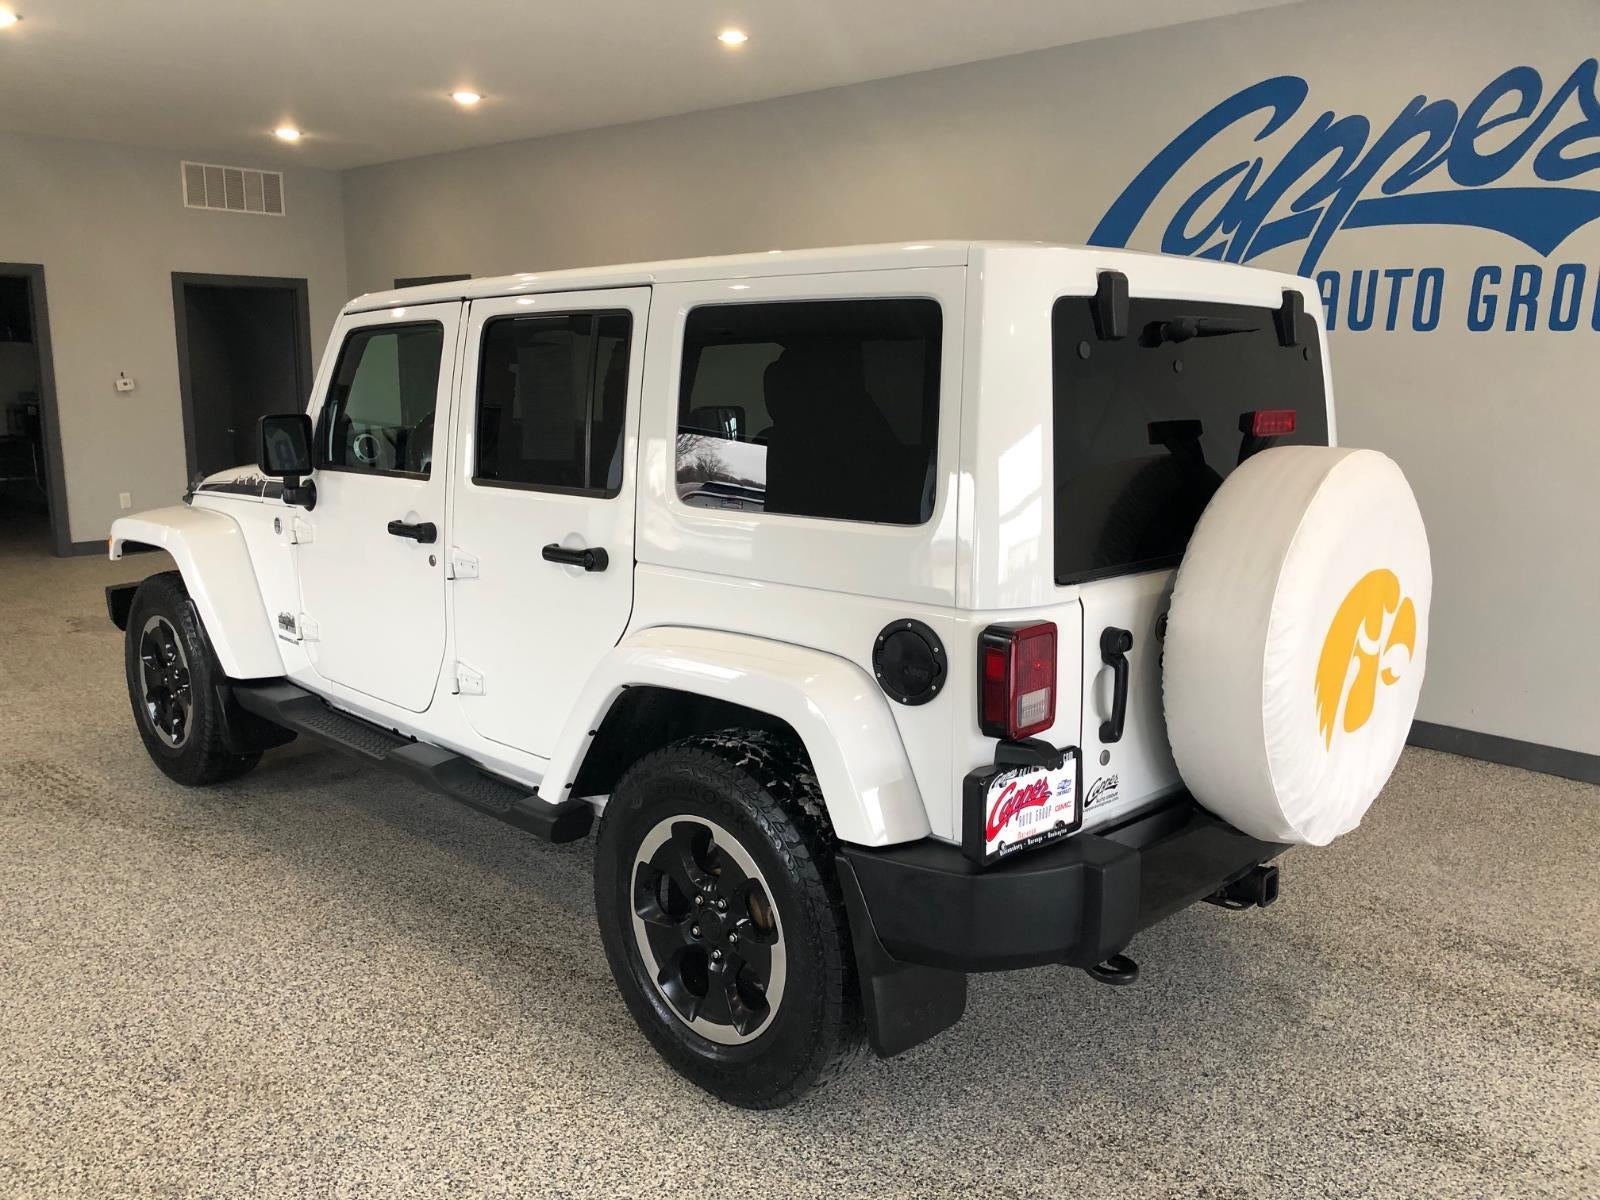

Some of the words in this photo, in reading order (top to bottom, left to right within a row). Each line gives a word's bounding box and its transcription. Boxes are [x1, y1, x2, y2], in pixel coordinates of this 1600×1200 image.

[1316, 267, 1445, 332] AUTO
[1467, 263, 1600, 332] GRO
[986, 776, 1053, 842] Cappes
[1054, 800, 1072, 812] GMC
